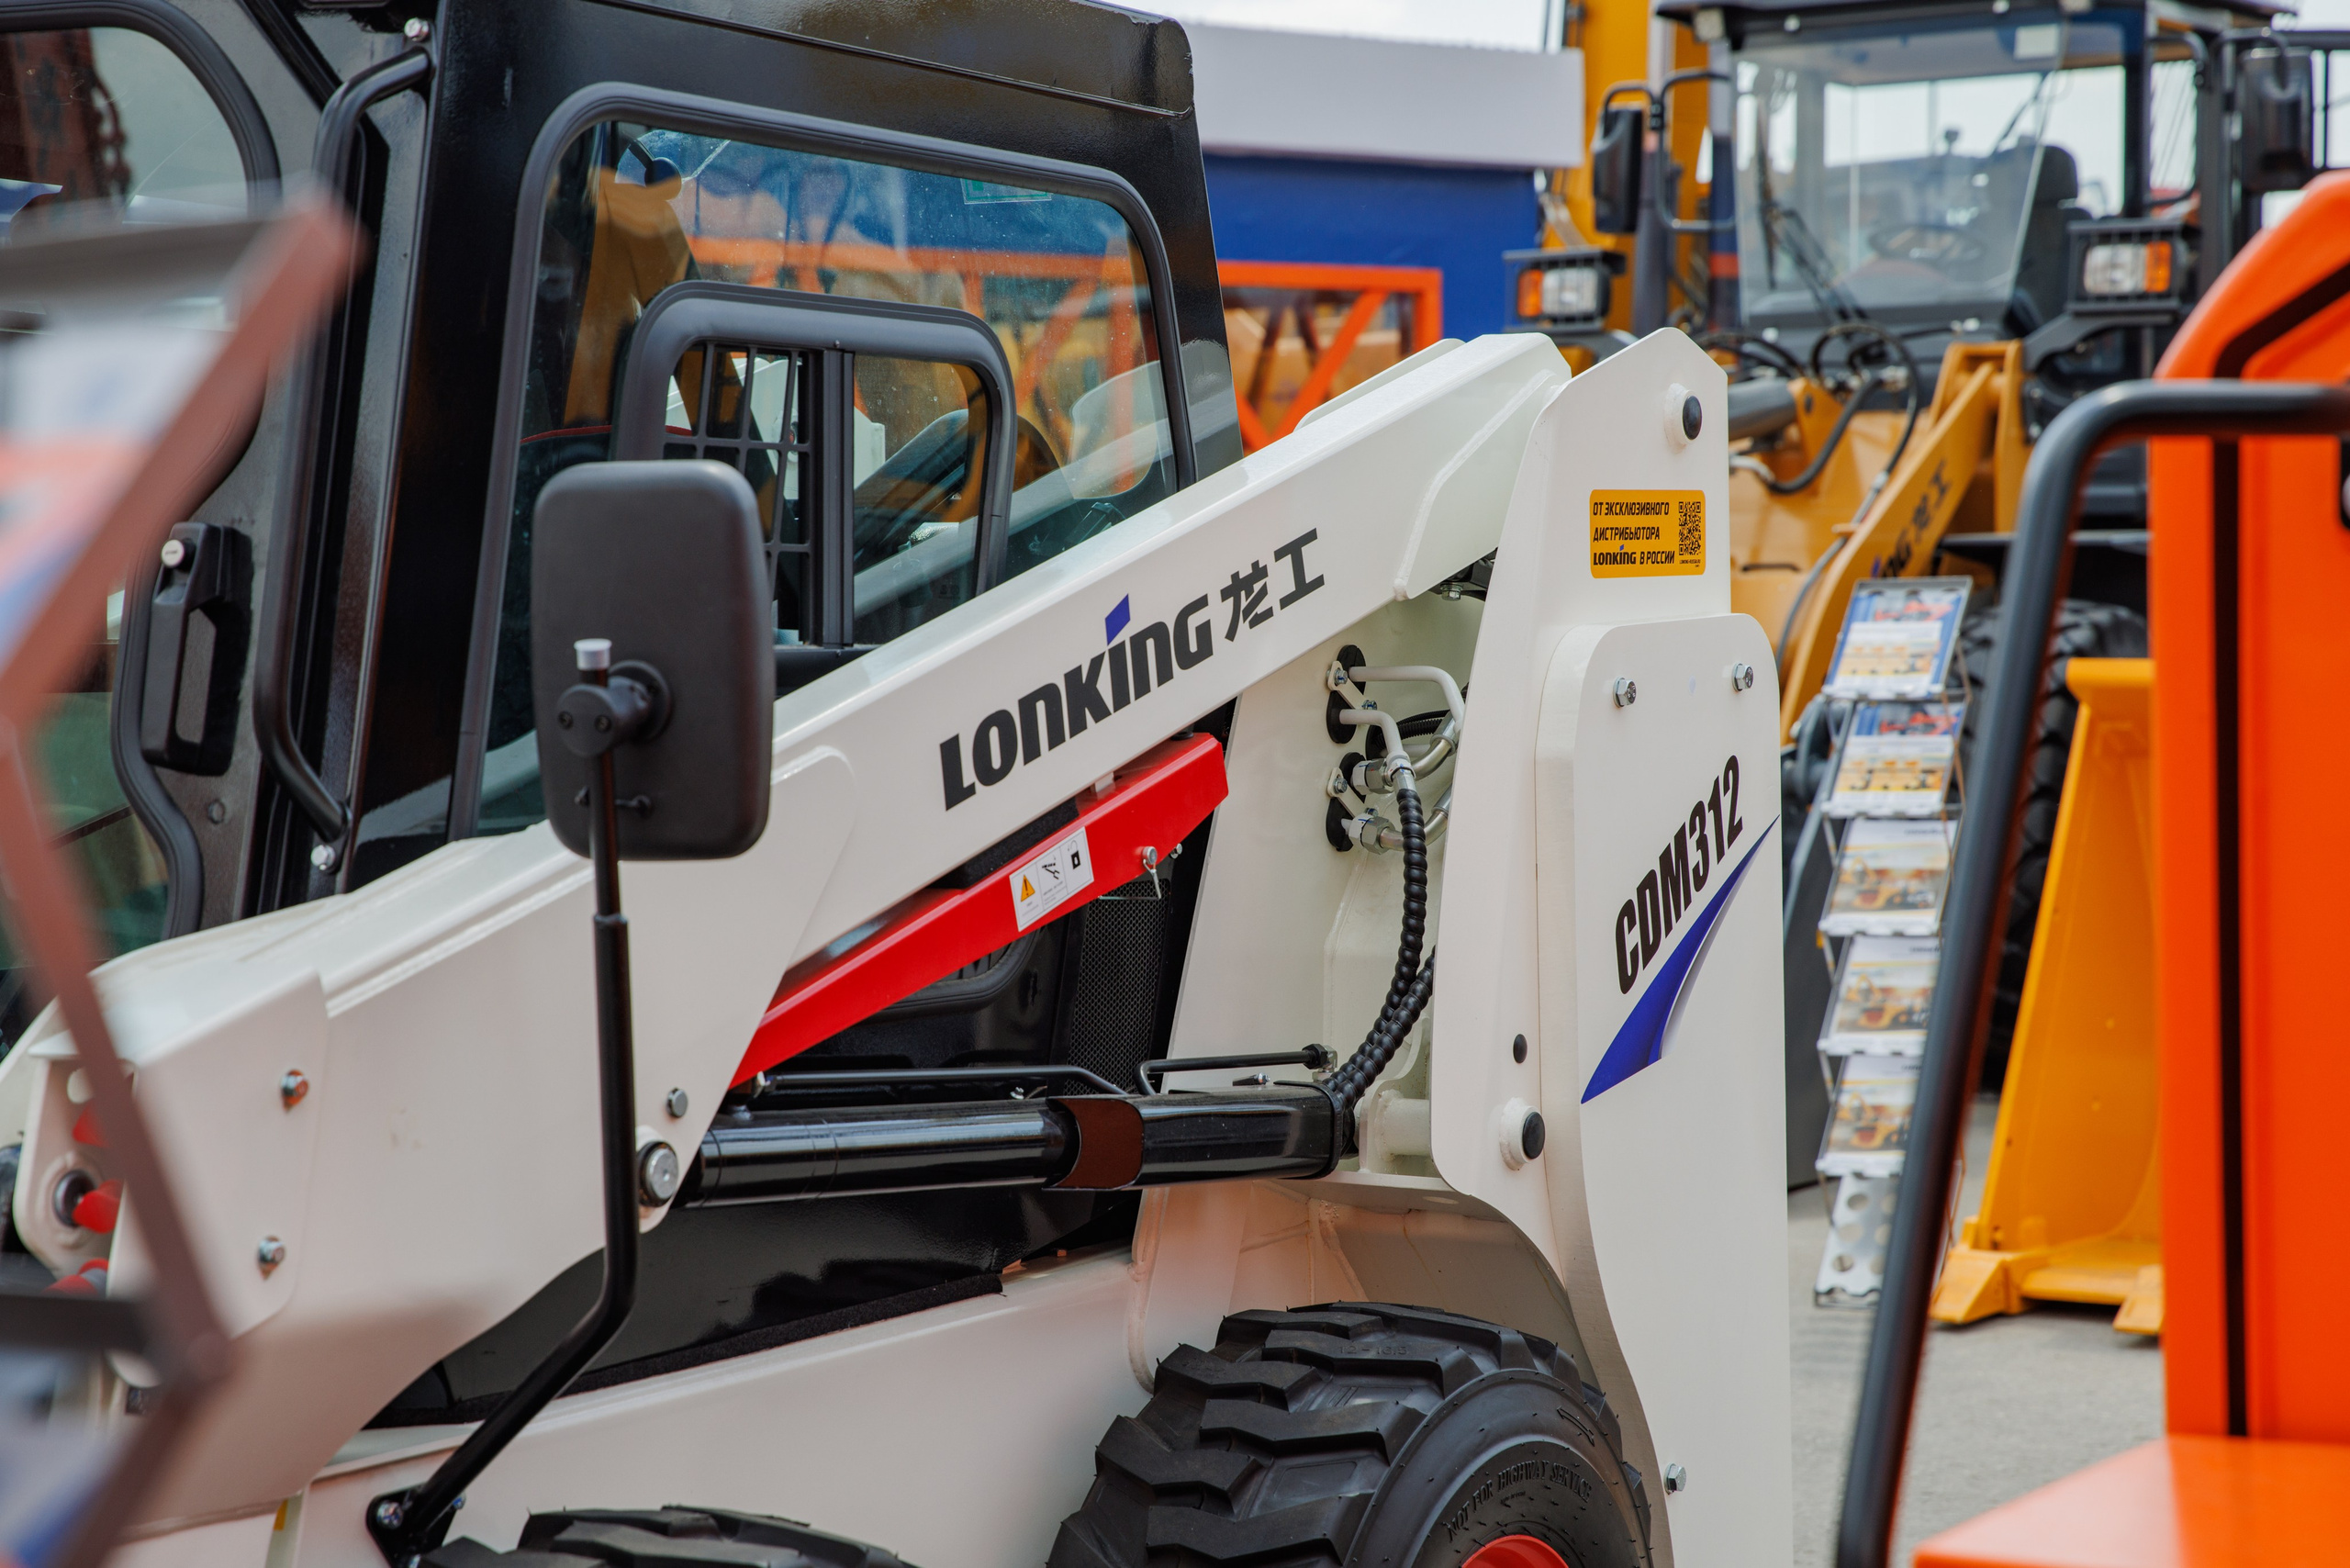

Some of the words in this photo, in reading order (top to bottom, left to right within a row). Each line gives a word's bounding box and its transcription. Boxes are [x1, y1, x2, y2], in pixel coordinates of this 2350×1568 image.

[1593, 501, 1604, 516] ОТ
[1605, 501, 1670, 516] ЭКСКЛЮЗИВНОГО
[1593, 526, 1661, 543] ДИСТРИБЬЮТОРА
[1639, 551, 1646, 565] В
[1646, 551, 1675, 565] РОССИИ
[940, 593, 1214, 812] LONKING
[1615, 755, 1743, 995] CDM312
[1444, 1500, 1470, 1543] NOT
[1472, 1479, 1494, 1513] FOR
[1497, 1460, 1550, 1493] HIGHWAY
[1550, 1462, 1594, 1503] SERVICE
